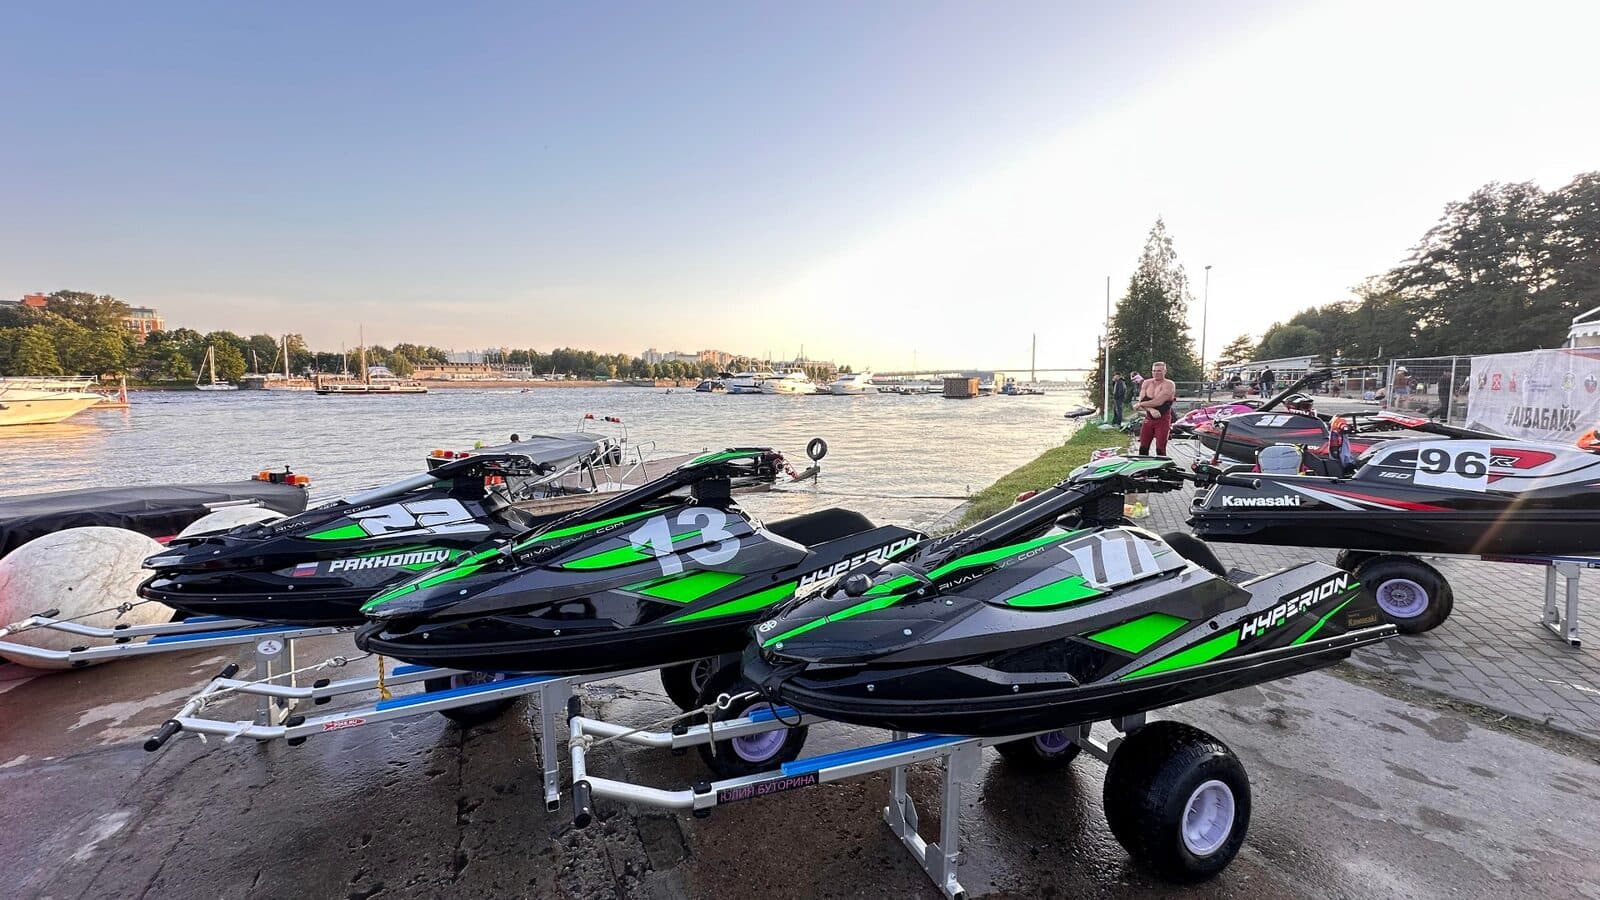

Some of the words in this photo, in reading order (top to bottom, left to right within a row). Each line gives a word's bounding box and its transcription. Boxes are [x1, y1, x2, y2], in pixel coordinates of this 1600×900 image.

[1420, 448, 1487, 479] 96
[350, 498, 476, 537] 22
[1222, 495, 1300, 507] Kawasaki
[329, 549, 450, 573] PAKHOMOV
[629, 507, 740, 576] 13
[799, 533, 922, 588] HYPERION
[1060, 529, 1144, 584] 77
[1240, 573, 1349, 641] HYPERION
[720, 786, 755, 802] ЮЛИЯ
[757, 774, 816, 795] БУТОРИНА
